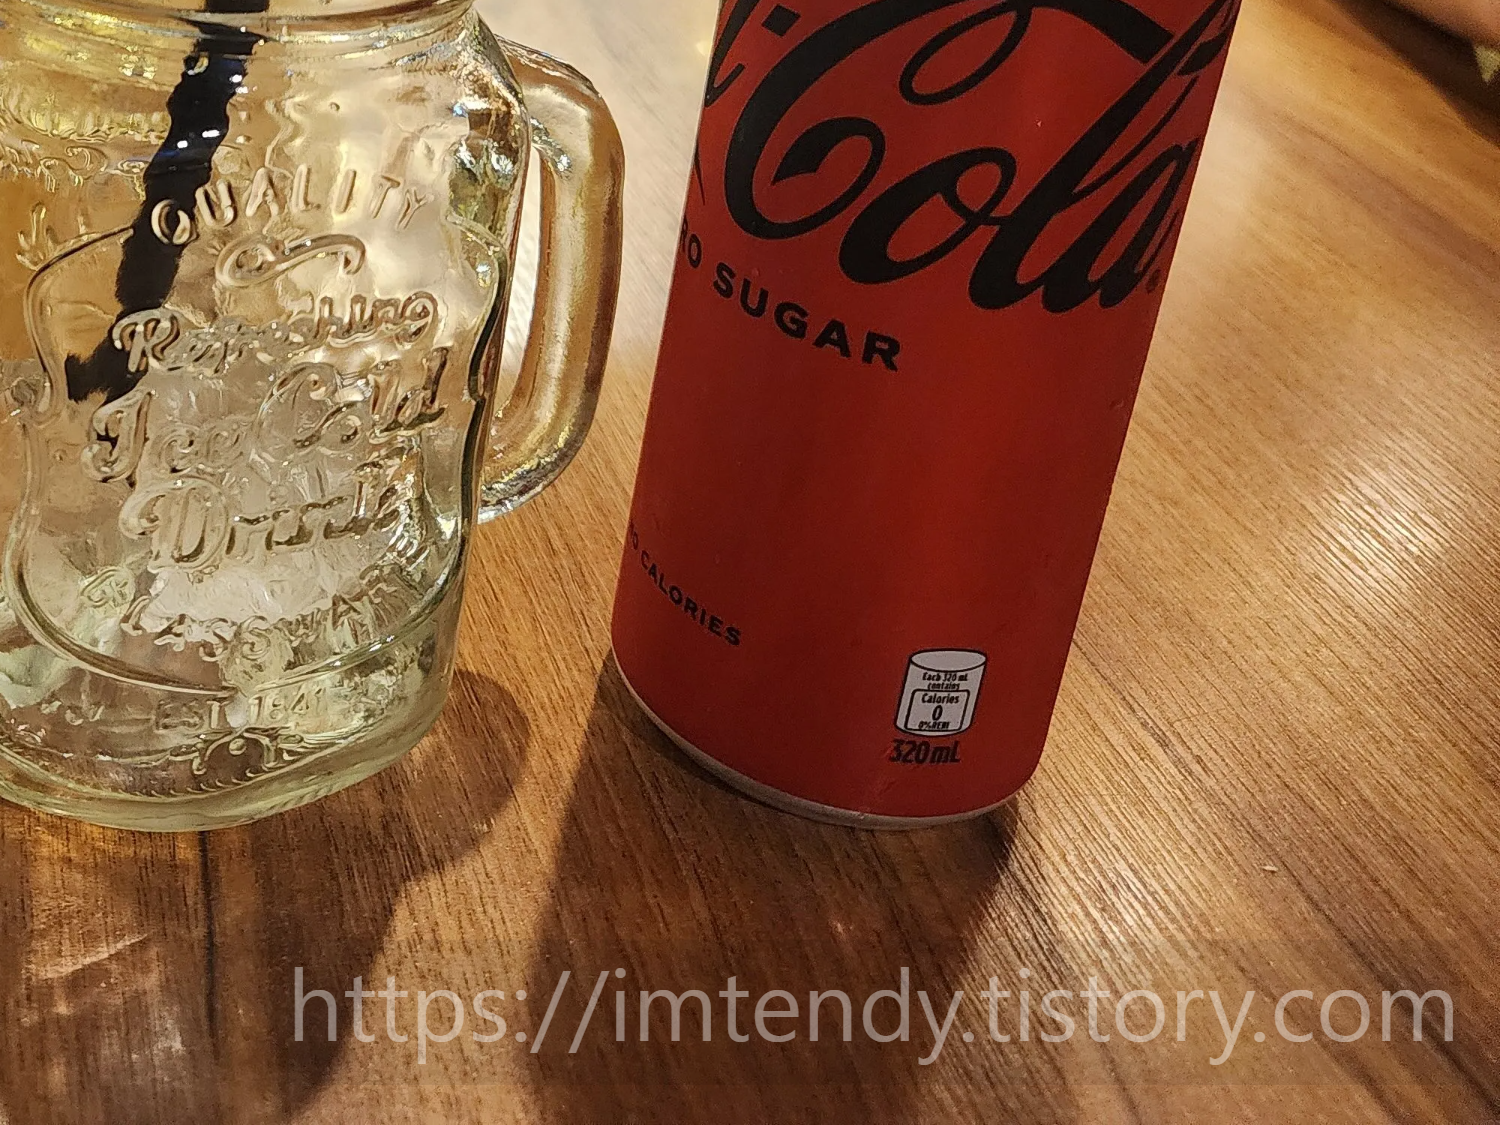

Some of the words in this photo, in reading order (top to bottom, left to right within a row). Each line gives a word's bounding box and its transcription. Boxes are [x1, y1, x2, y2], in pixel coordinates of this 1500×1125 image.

[150, 165, 433, 246] QUALITY
[713, 262, 900, 372] SUGAR
[641, 550, 740, 646] CALORIES
[921, 693, 960, 704] Calories
[942, 672, 957, 682] 320
[932, 704, 943, 721] 0
